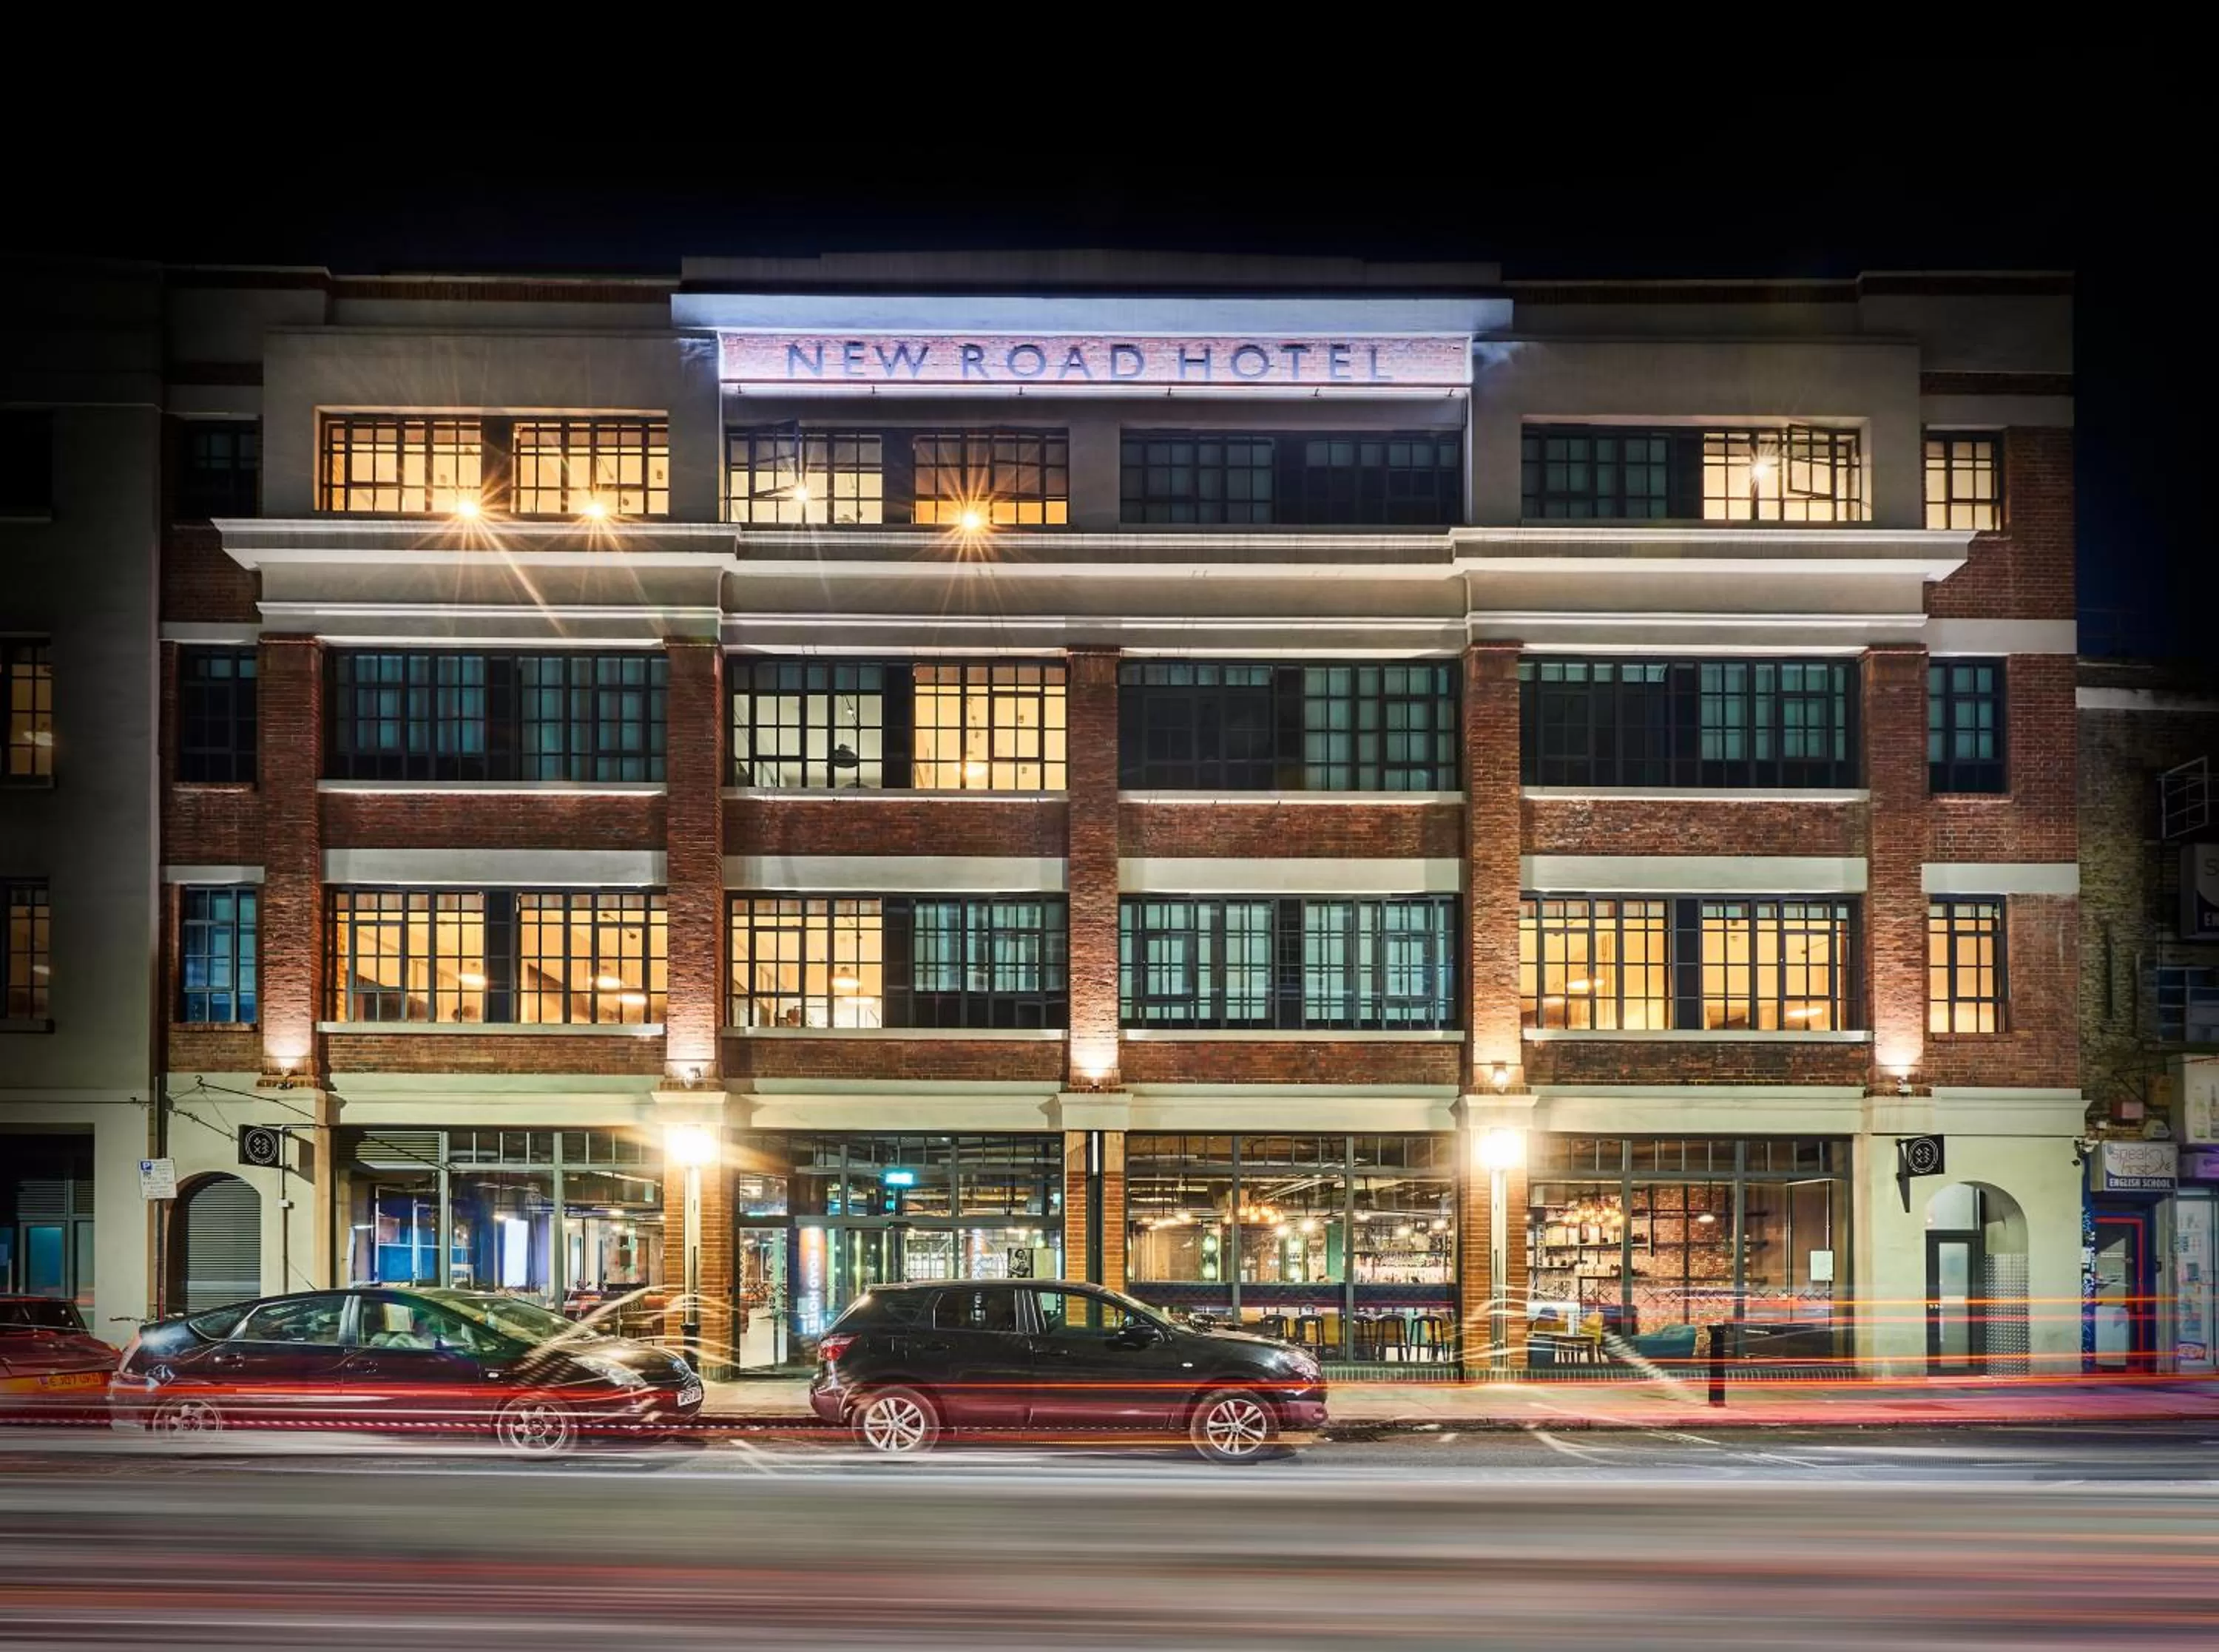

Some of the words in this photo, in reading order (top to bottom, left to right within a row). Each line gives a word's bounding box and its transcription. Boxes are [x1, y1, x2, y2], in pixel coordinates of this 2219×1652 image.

[786, 341, 930, 378] NEW
[961, 342, 1144, 379] ROAD
[1178, 343, 1393, 380] HOTEL
[2109, 1178, 2141, 1187] ENGLISH
[2142, 1178, 2171, 1188] SCHOOL
